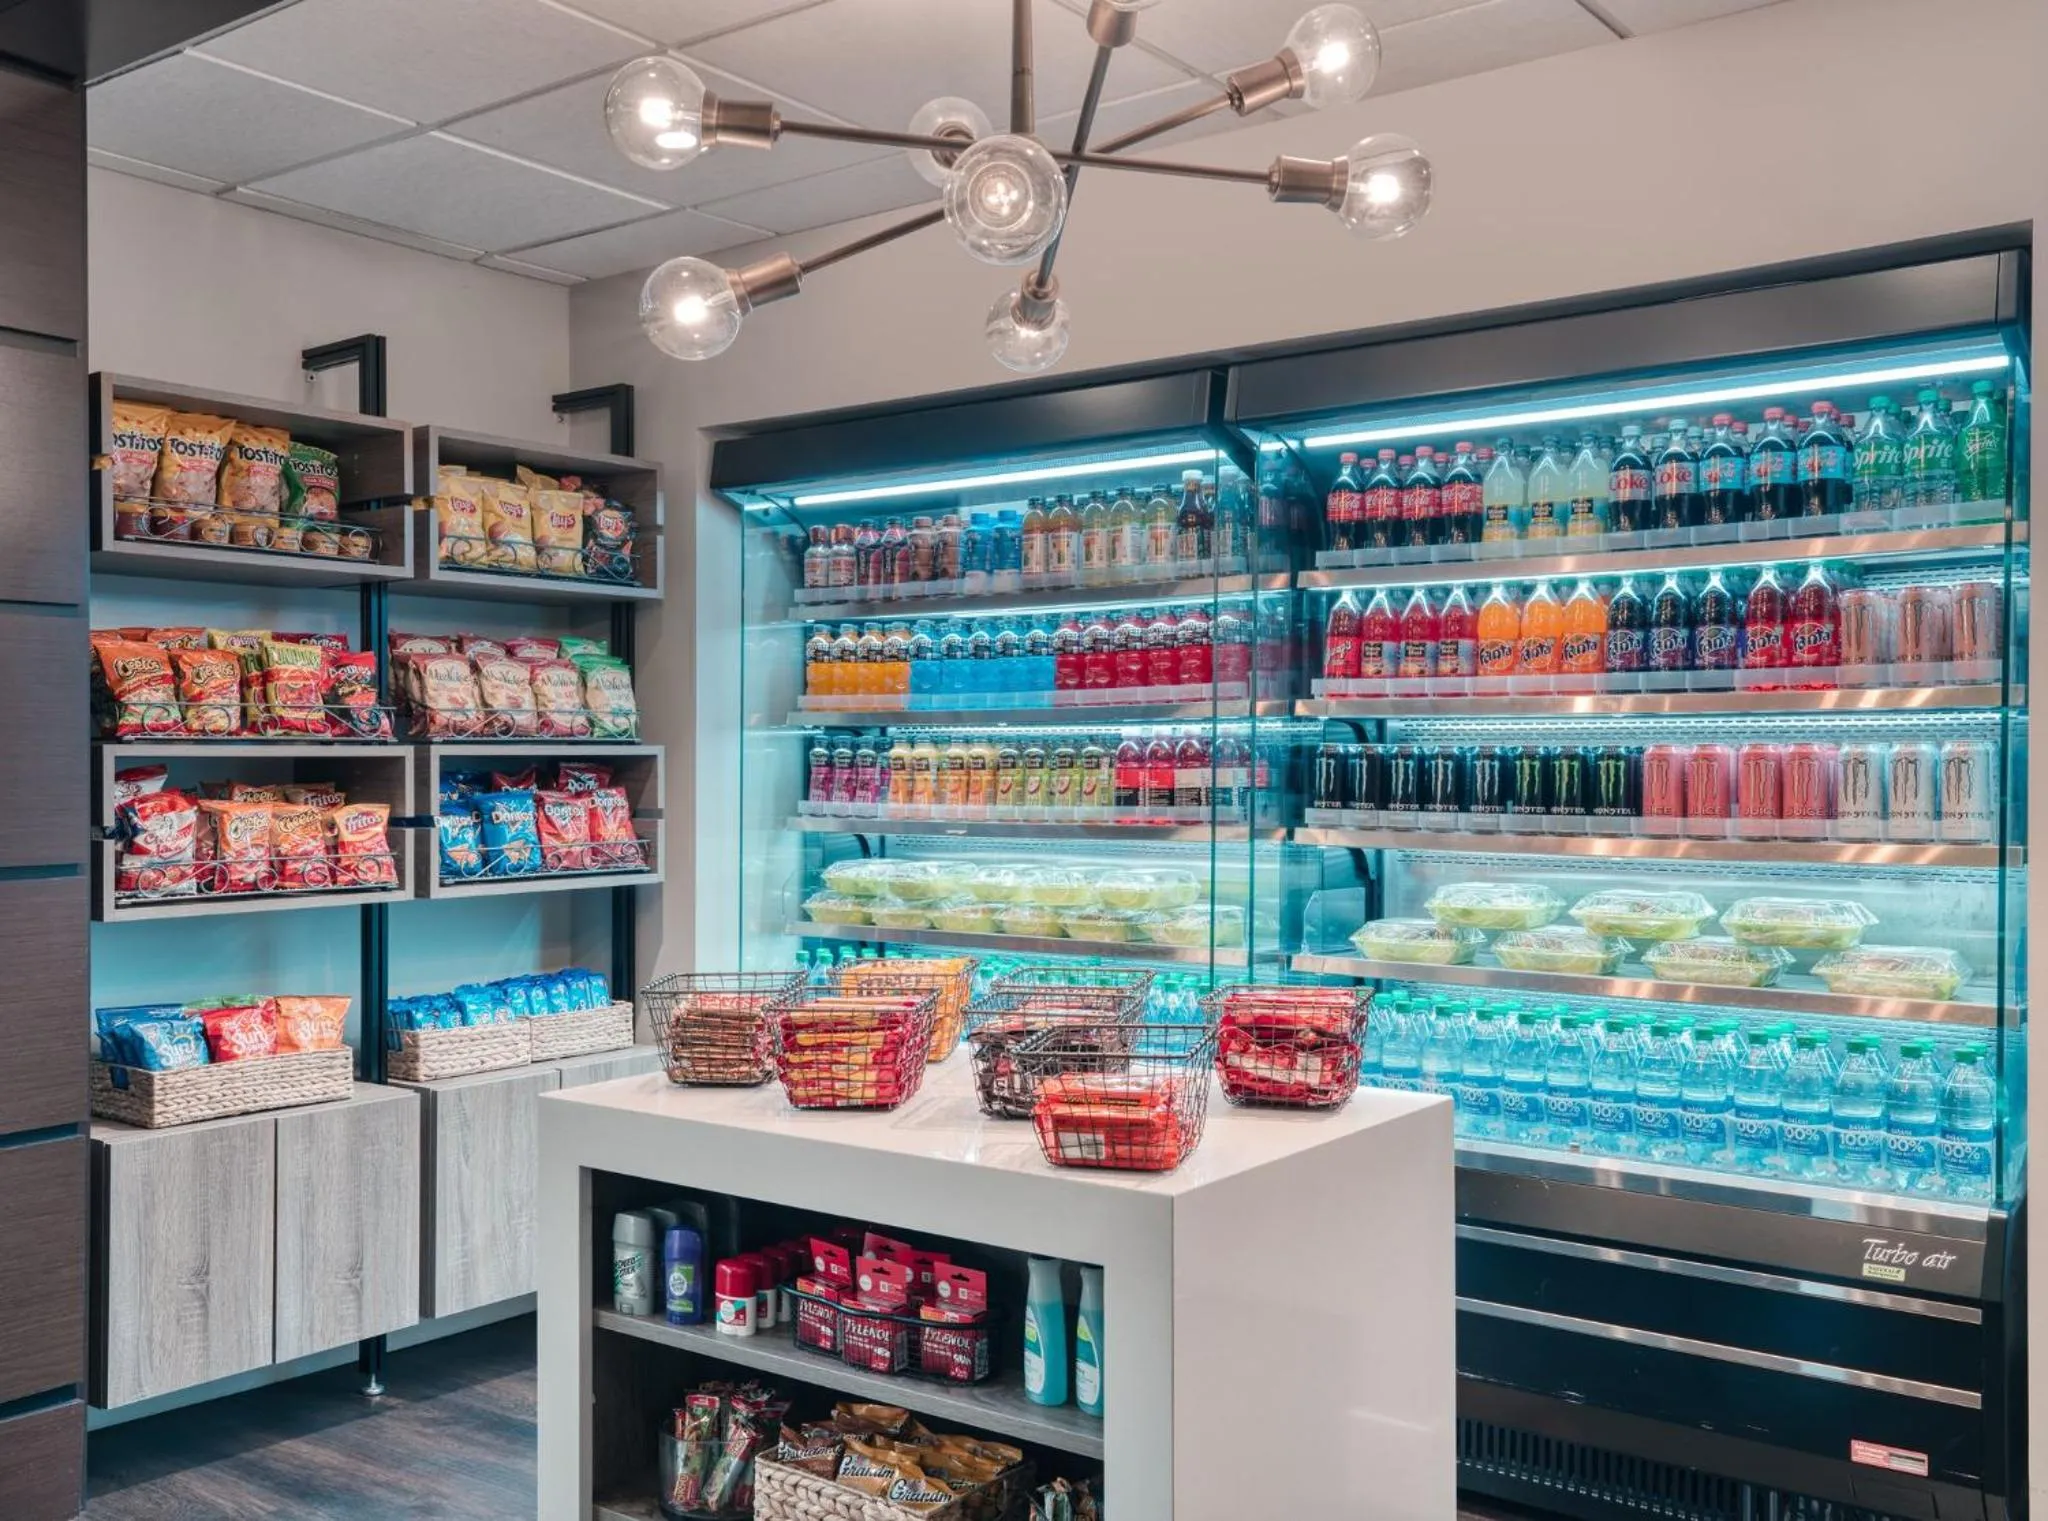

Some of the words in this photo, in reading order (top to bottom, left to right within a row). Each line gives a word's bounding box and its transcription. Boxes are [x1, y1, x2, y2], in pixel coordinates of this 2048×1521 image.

[168, 437, 224, 462] Tostito
[1862, 1238, 1919, 1266] Turbo
[1922, 1250, 1957, 1271] air
[844, 1318, 892, 1342] TYLENOL
[890, 1478, 953, 1504] Grandm
